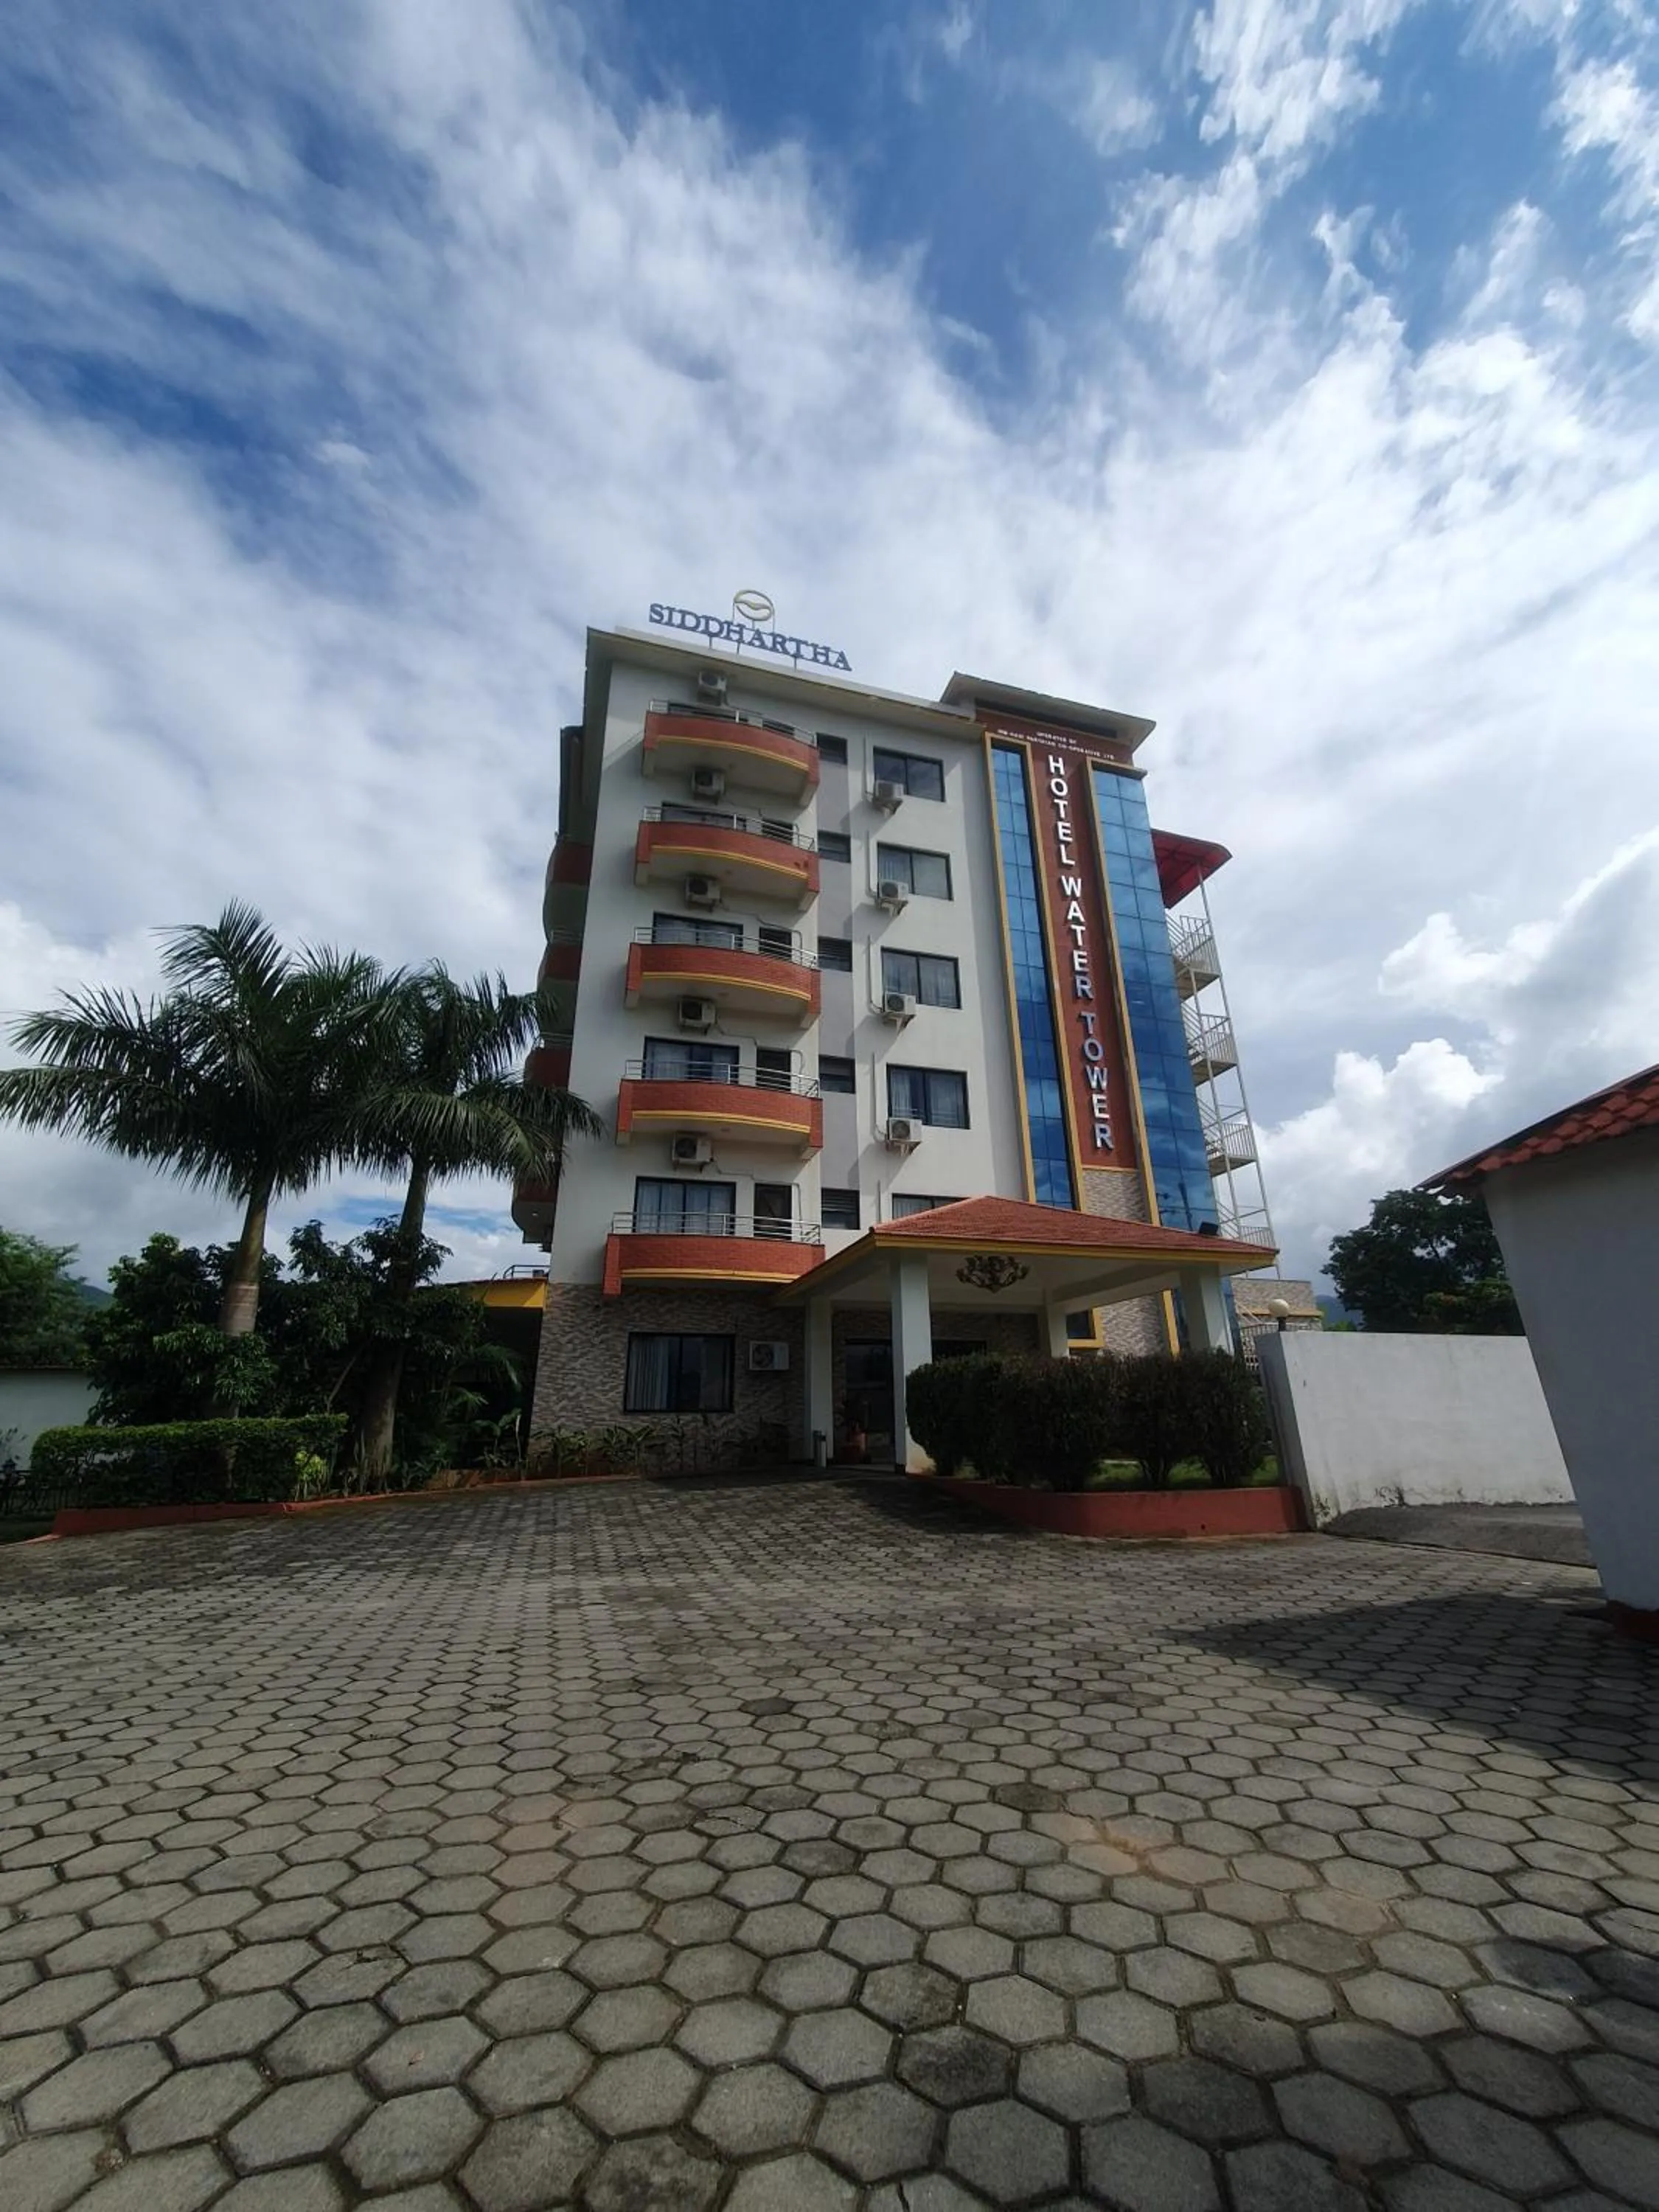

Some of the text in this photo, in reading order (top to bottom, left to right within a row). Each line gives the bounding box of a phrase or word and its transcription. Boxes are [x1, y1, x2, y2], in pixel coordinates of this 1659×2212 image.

[649, 603, 852, 671] SIDDHARTHA
[1048, 755, 1114, 1150] HOTEL WATER TOWER
